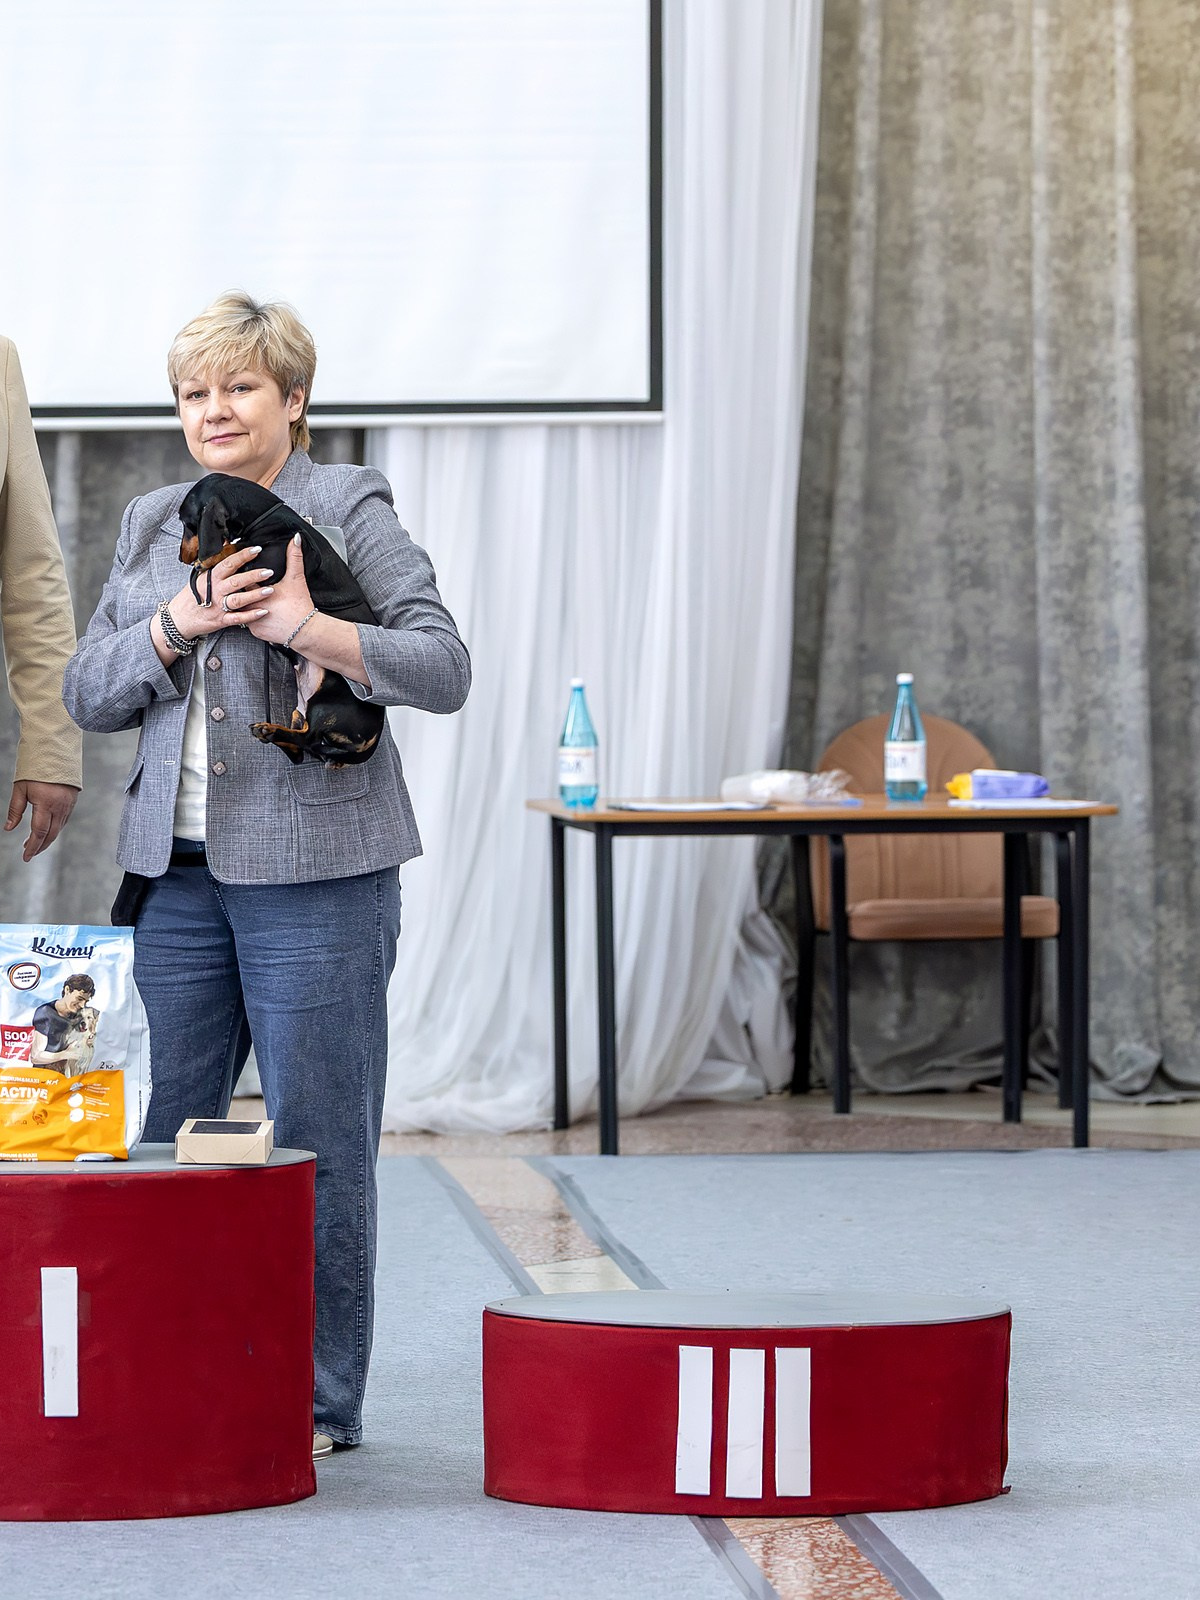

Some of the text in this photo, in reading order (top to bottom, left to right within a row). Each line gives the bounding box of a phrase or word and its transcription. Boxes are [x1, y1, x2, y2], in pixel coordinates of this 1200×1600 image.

[31, 936, 95, 959] Karmy
[99, 1061, 105, 1069] 2
[0, 1086, 49, 1100] ACTIVE
